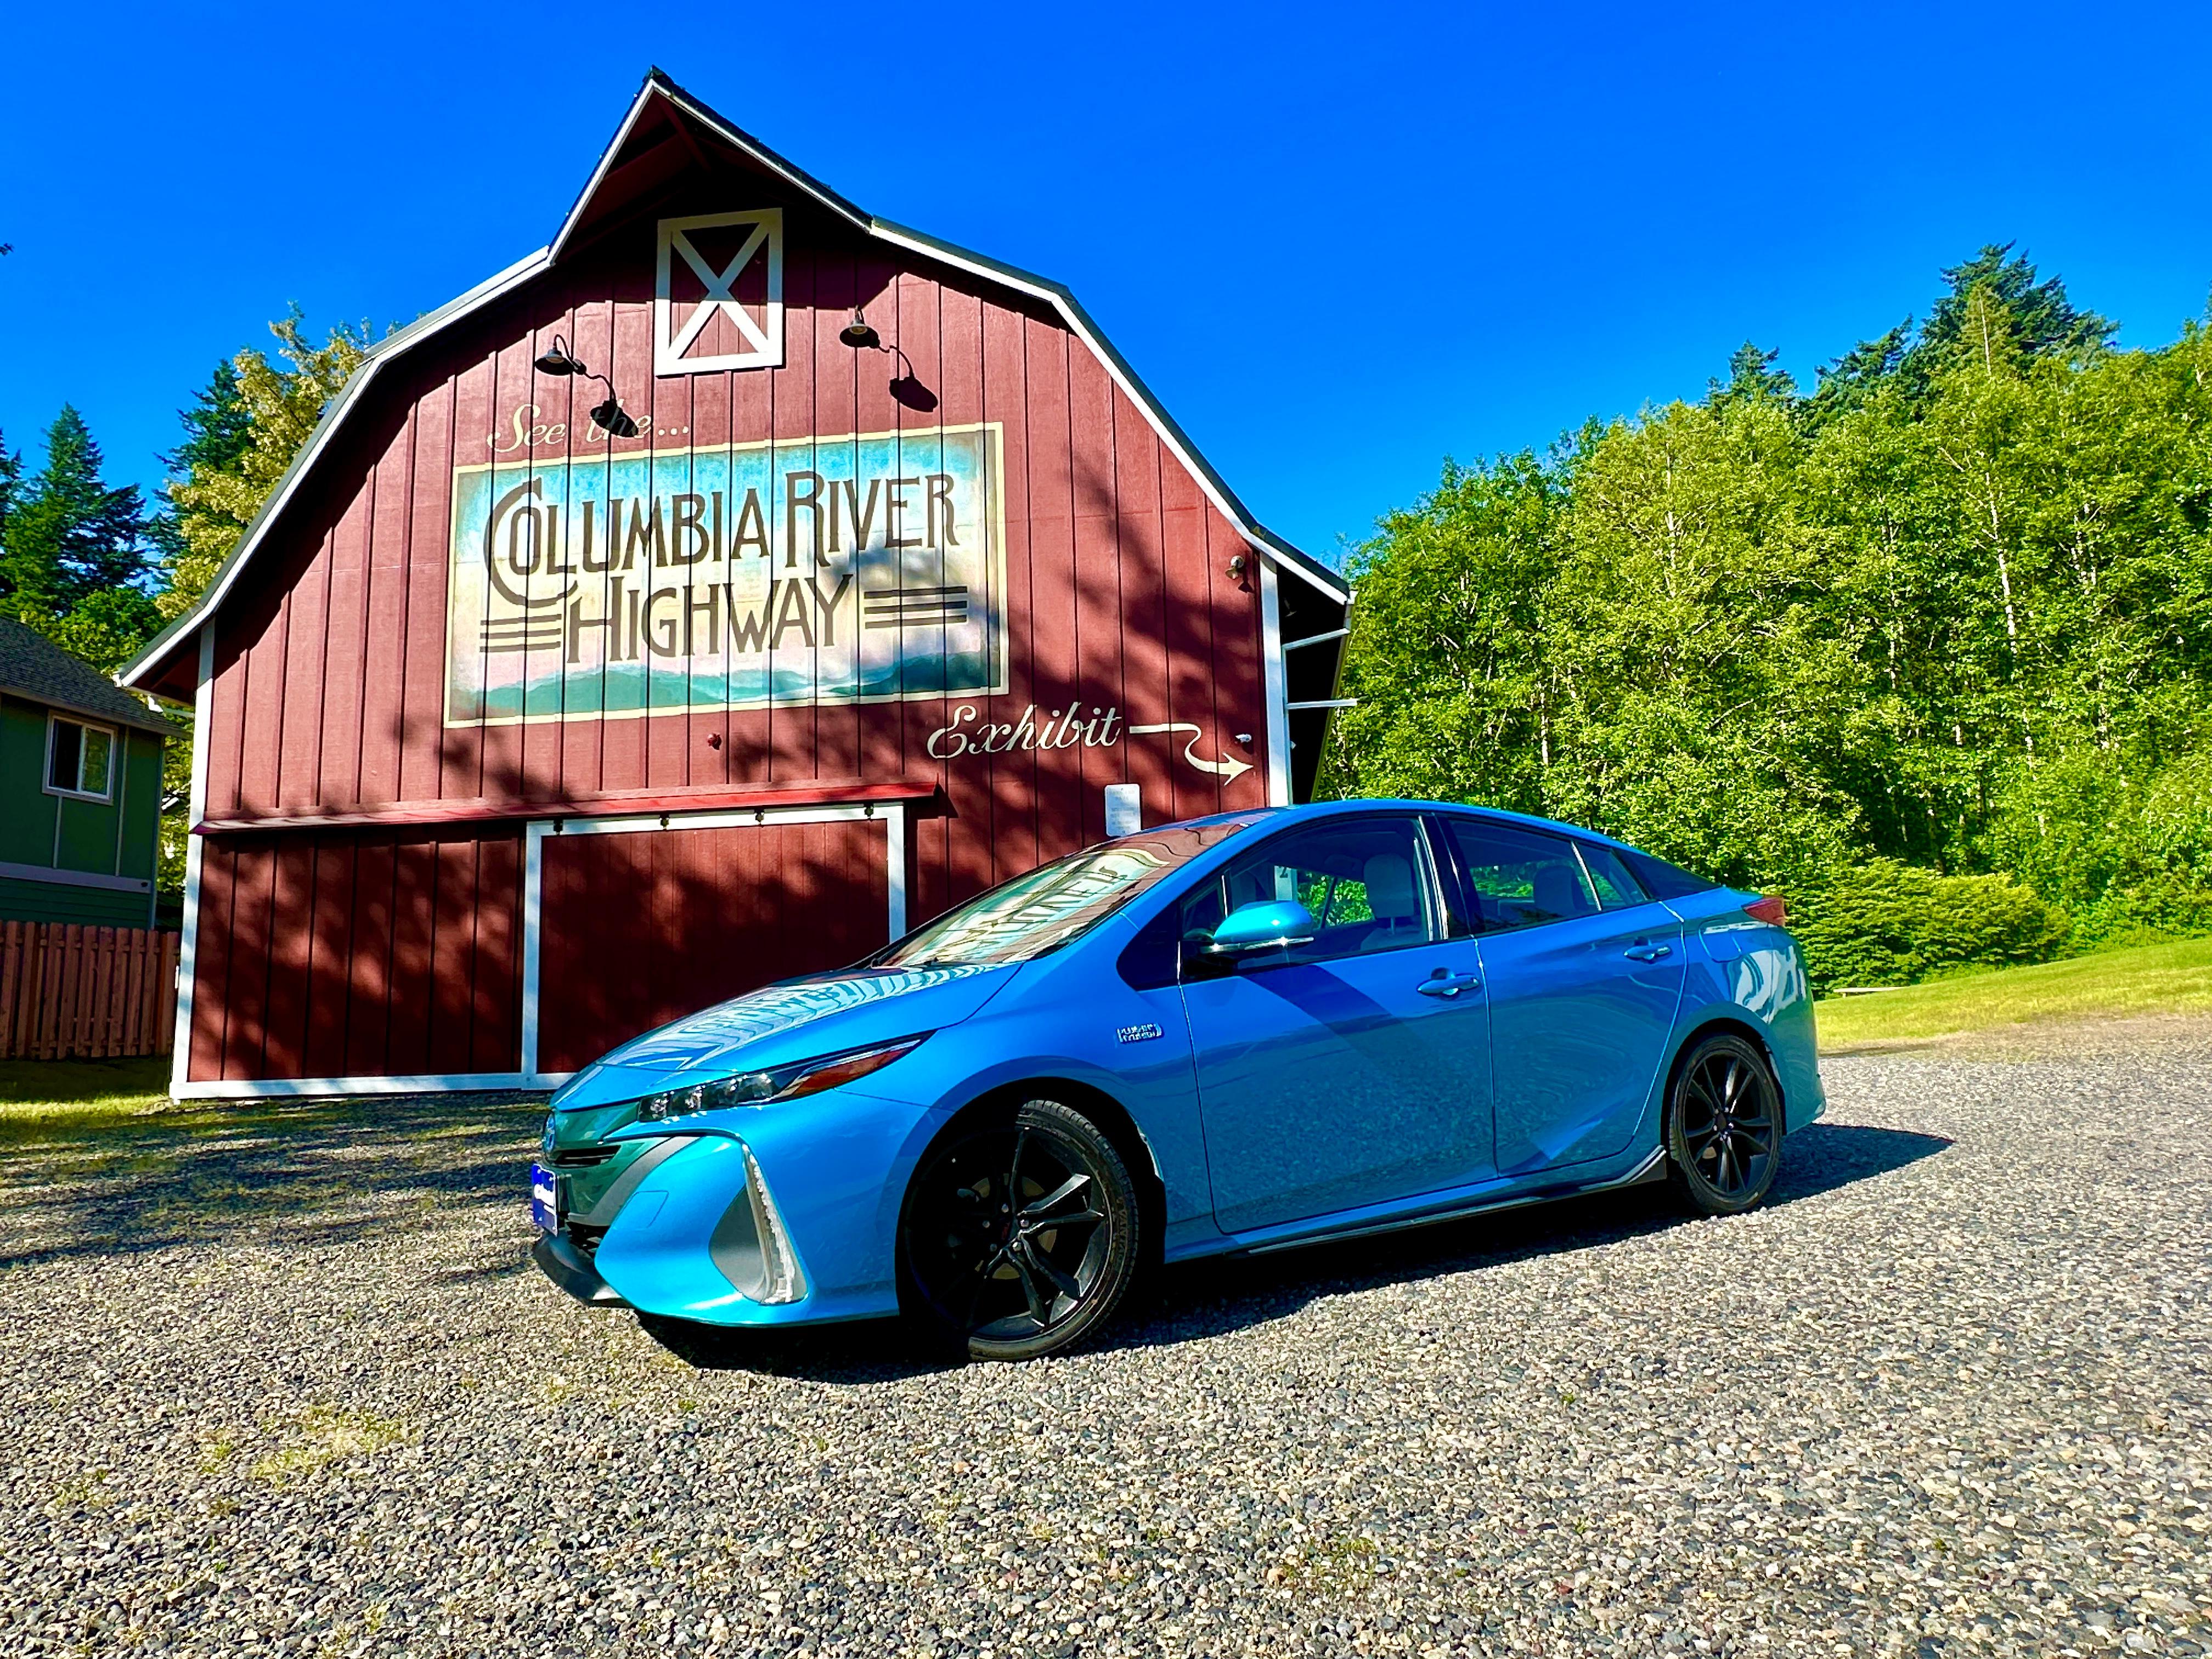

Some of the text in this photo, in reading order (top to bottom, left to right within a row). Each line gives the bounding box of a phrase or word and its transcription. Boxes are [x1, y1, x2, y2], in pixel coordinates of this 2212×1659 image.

[487, 404, 566, 453] See
[483, 470, 960, 609] COLUMBIA RIVER
[567, 574, 853, 663] HIGHWAY
[927, 701, 1122, 759] Exhibit
